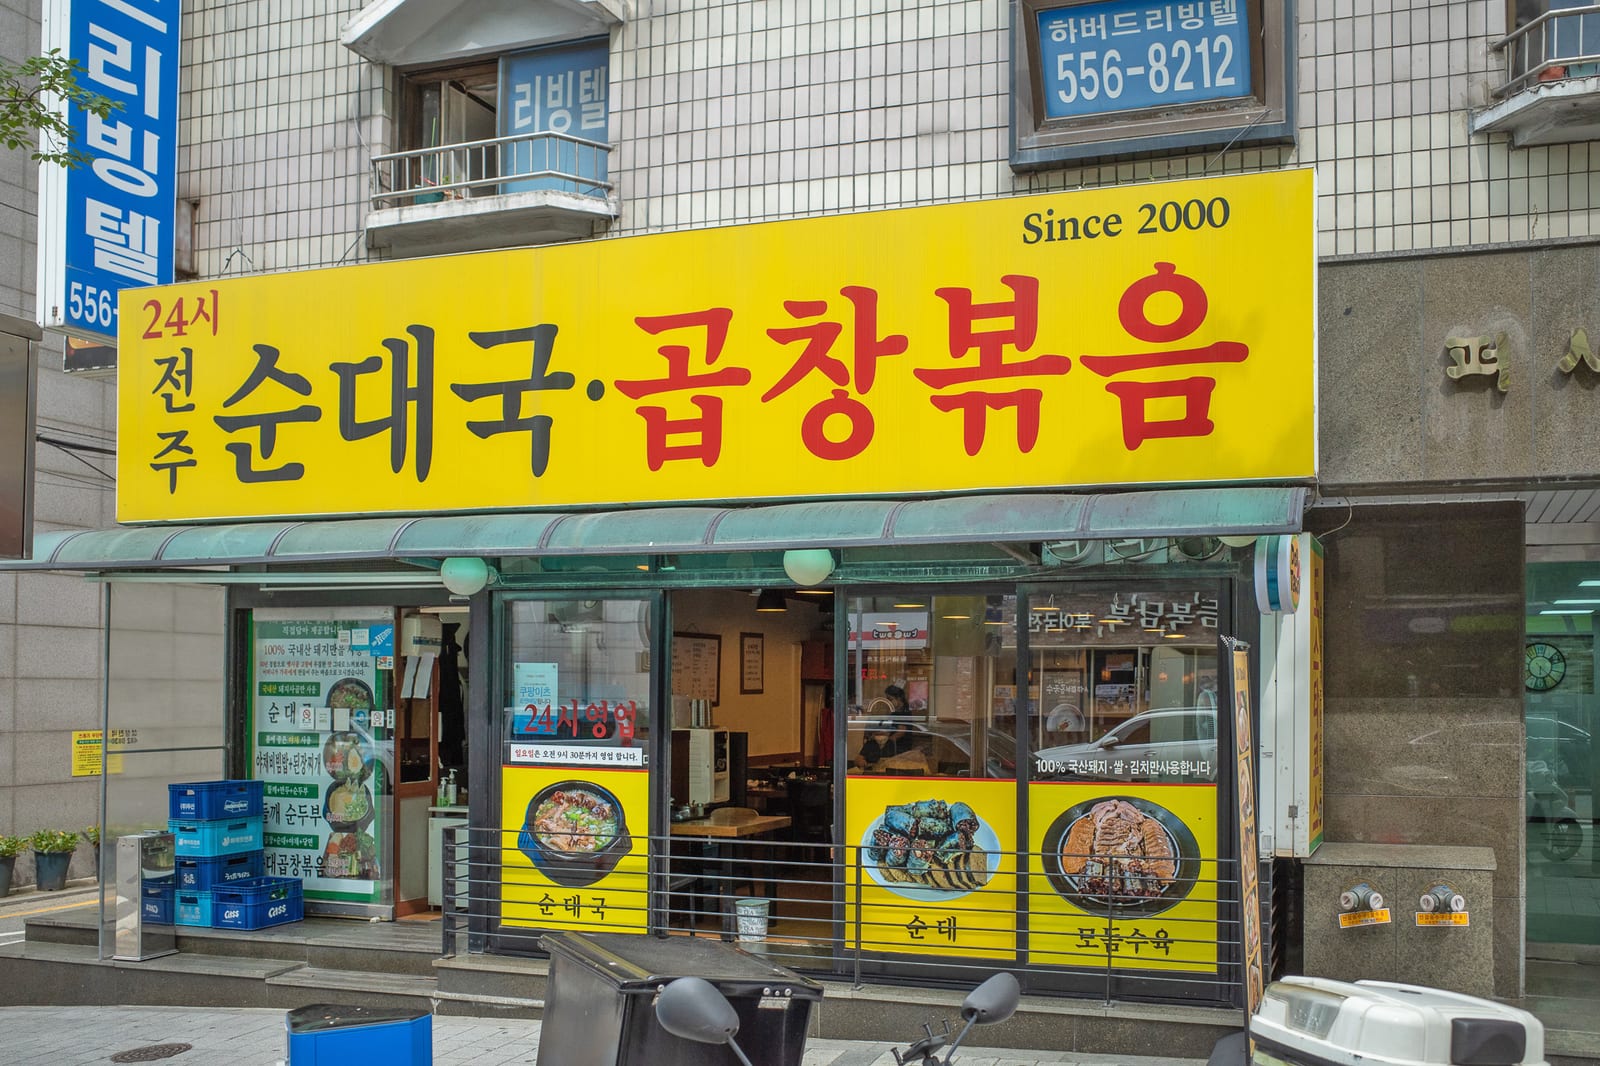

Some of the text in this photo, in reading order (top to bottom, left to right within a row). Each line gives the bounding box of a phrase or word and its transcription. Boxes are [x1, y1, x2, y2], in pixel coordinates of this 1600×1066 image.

[1049, 0, 1239, 44] 하버드리빙텔
[1057, 34, 1236, 103] 556-8212
[514, 66, 607, 133] 리빙텔
[1021, 196, 1231, 245] Since 2000
[142, 289, 219, 340] 24시
[264, 644, 285, 655] 100%
[288, 643, 311, 656] 국내산
[519, 686, 551, 697] 쿠팡이츠
[515, 748, 541, 758] 일요일은
[542, 749, 555, 759] 오전
[557, 750, 568, 759] 9시
[1035, 760, 1066, 773] 100%
[285, 803, 321, 828] 순두부
[263, 852, 326, 877] 대곱창볶음
[538, 892, 607, 920] 순대국
[905, 915, 957, 942] 순대
